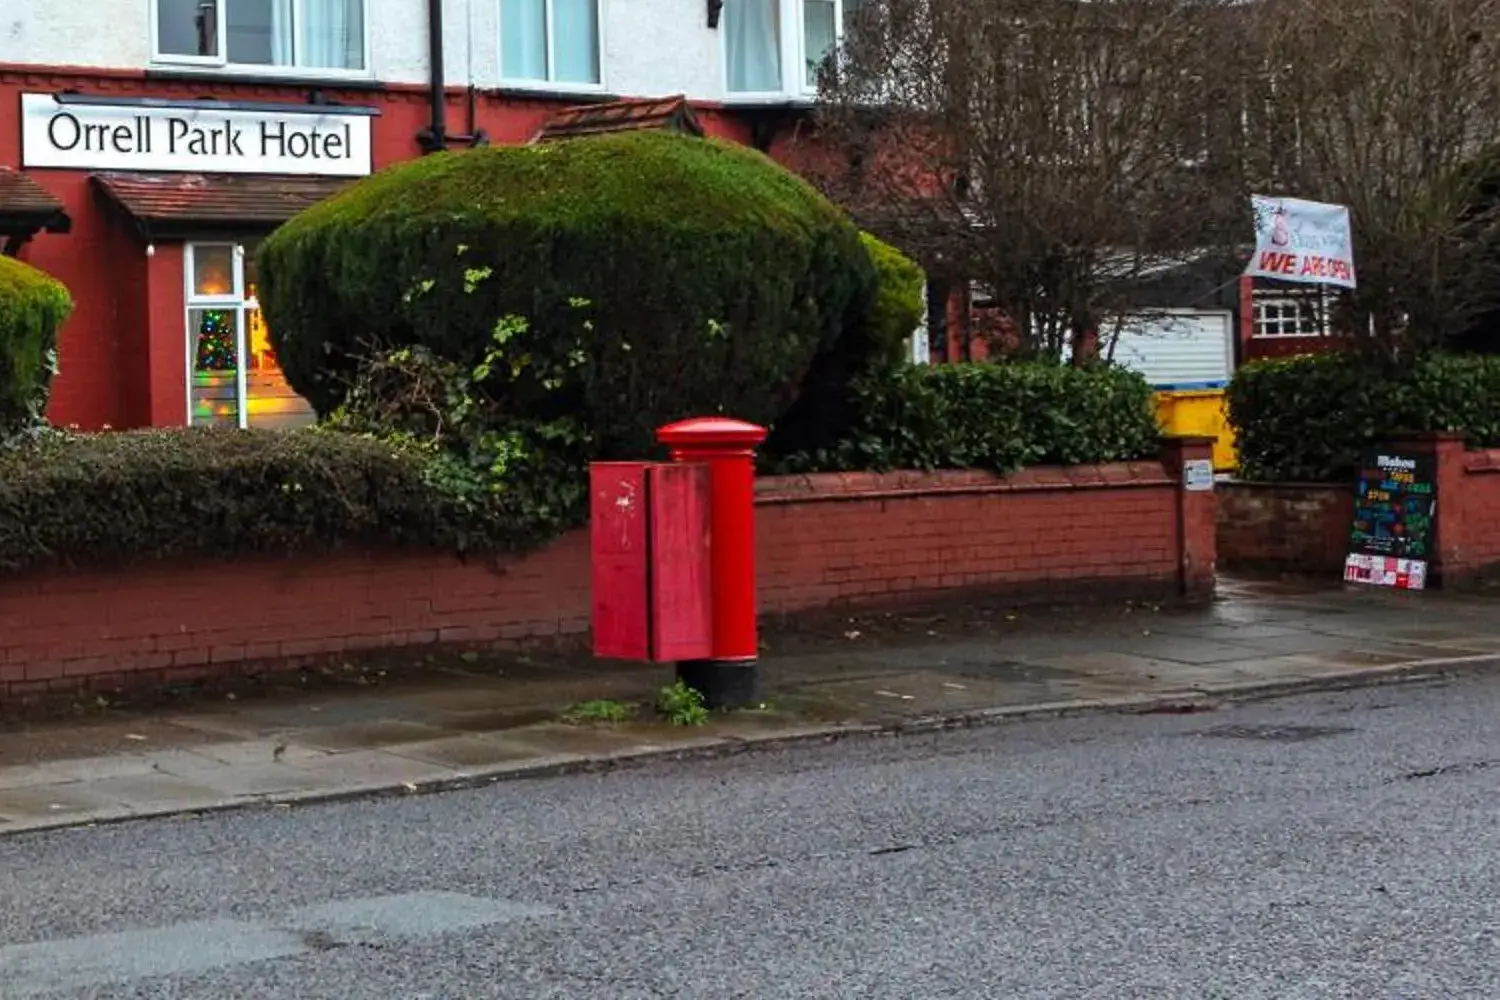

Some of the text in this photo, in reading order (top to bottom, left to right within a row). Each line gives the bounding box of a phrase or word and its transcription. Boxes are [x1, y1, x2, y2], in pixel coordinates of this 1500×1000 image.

[48, 112, 352, 159] Orrell Park Hotel
[1258, 251, 1297, 274] WE
[1300, 255, 1327, 277] ARE
